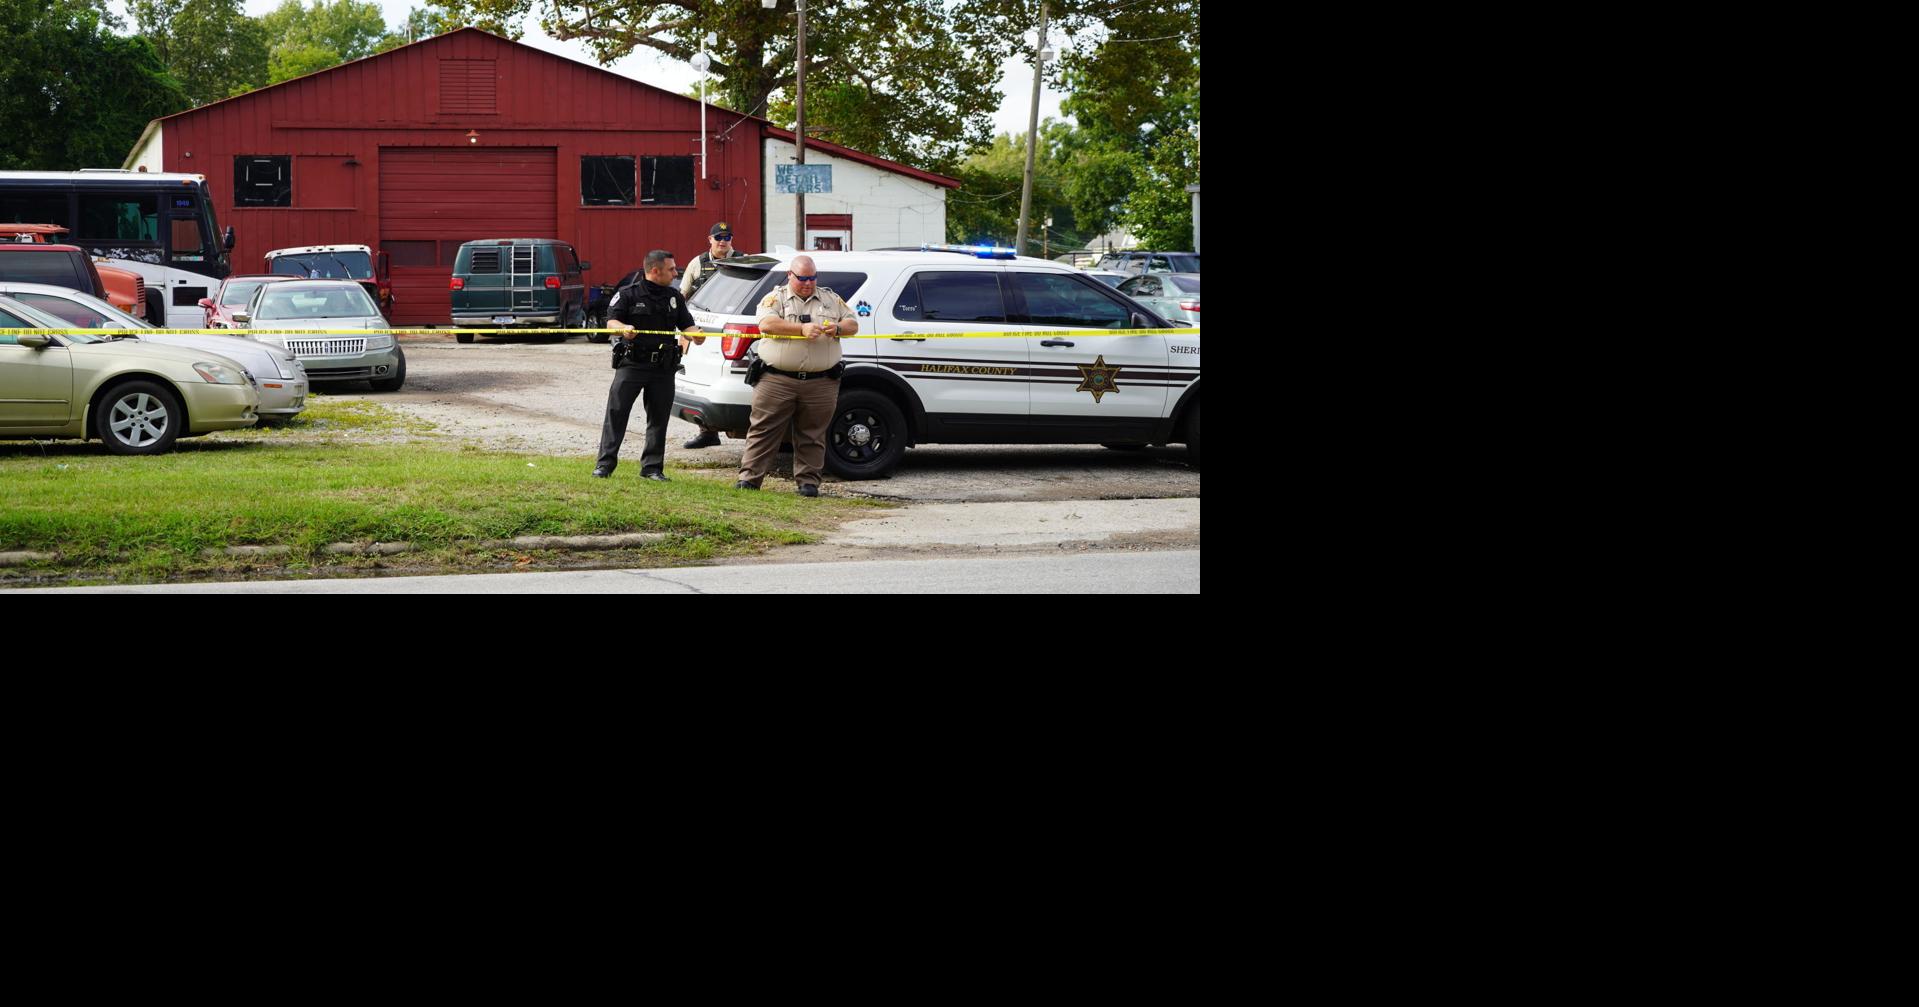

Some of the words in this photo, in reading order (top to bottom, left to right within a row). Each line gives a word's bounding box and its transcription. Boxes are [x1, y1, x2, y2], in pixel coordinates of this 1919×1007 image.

[777, 165, 793, 174] WE
[776, 175, 820, 185] DETAIL
[788, 184, 821, 193] CARS
[921, 364, 970, 374] HALIFAX
[971, 367, 1017, 376] COUNTY
